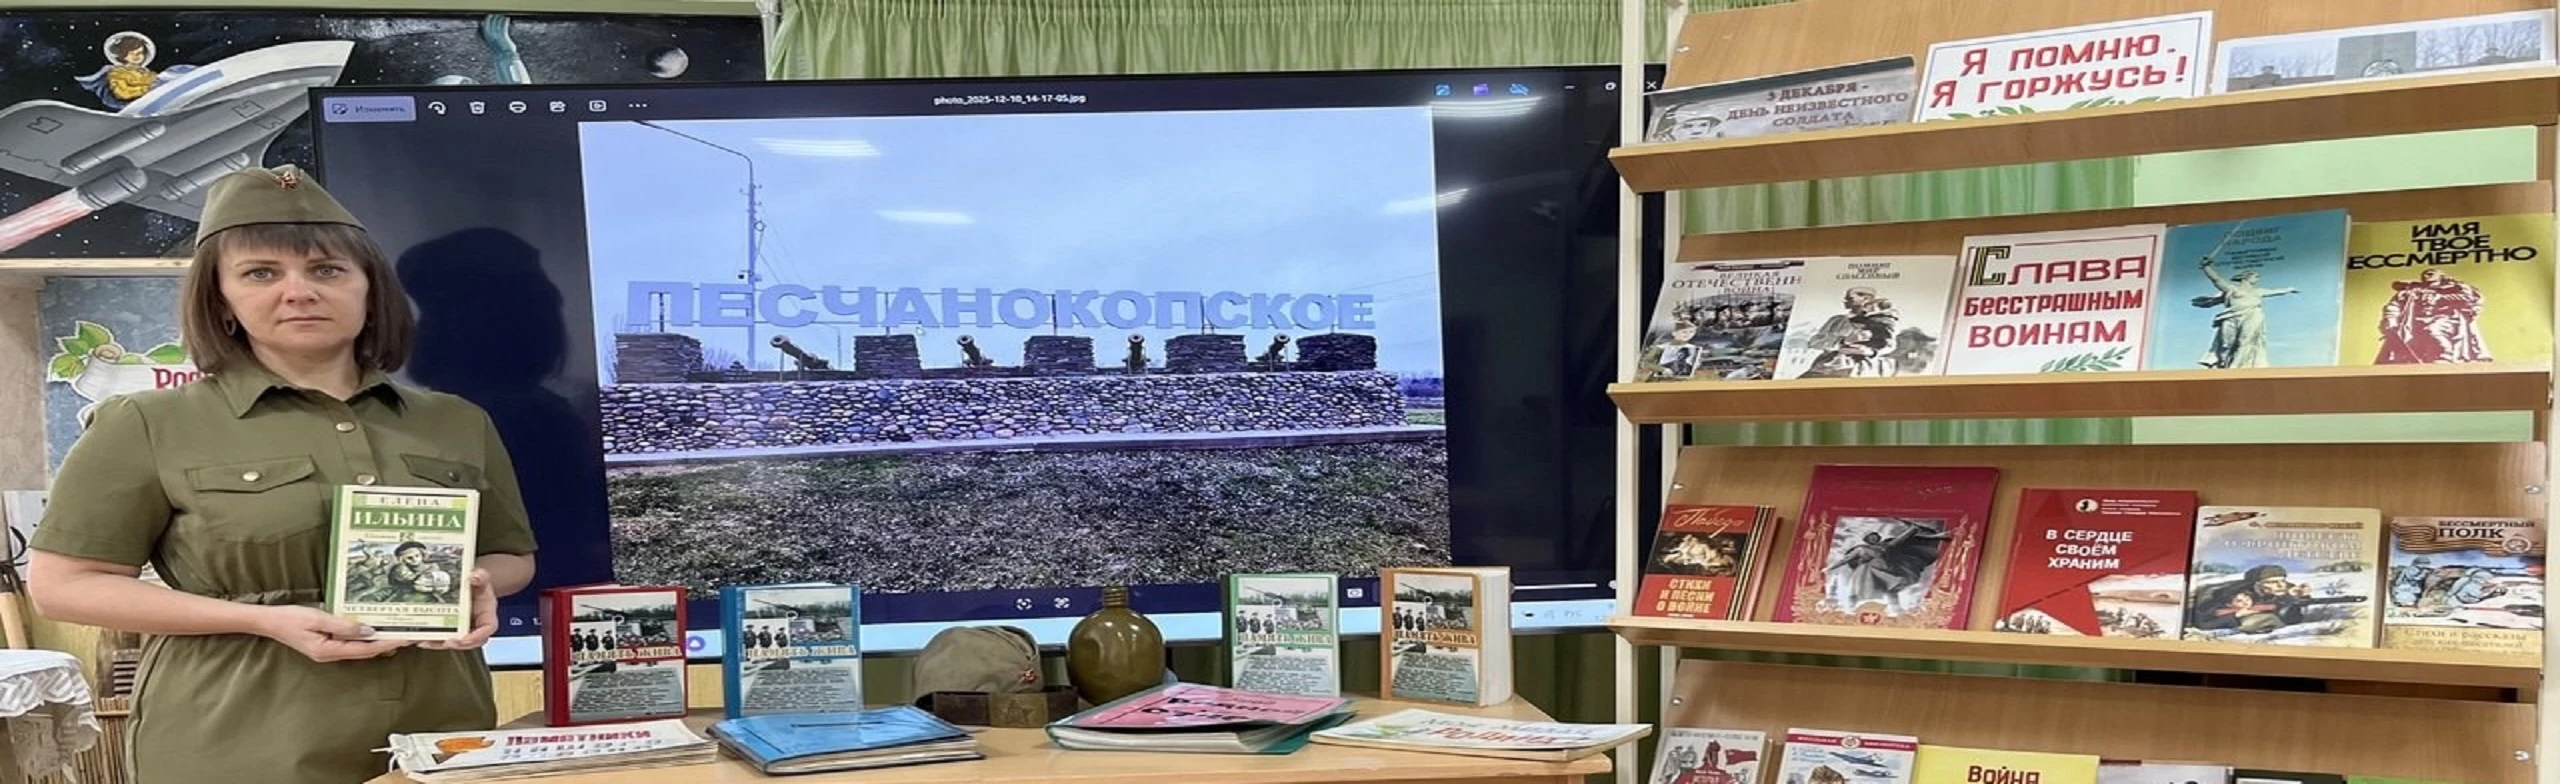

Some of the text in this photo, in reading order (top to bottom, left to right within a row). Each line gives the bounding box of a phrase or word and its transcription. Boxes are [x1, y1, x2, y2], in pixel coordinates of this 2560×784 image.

[1960, 48, 1989, 77] Я
[1930, 56, 2187, 108] Я ГОРЖУСЬ!
[1779, 82, 1858, 100] ДЕКАБРЯ
[1727, 92, 1909, 120] ДЕНЬ НЕИЗВЕСТНОГО
[1773, 111, 1855, 127] СОЛДАТА
[2412, 222, 2480, 239] ИМЯ
[2411, 235, 2491, 252] ТВОЕ
[1968, 245, 2146, 286] СЛАВА
[2348, 246, 2537, 269] ЕССМЕРТНО
[627, 281, 1376, 330] ПЕСЧАНОКОПСКОЕ
[1968, 320, 2127, 348] ВОИНАМ
[380, 494, 440, 506] ЕЛЕНА
[353, 511, 462, 528] ИЛЬИНА
[2437, 520, 2535, 528] БЕССМЕРТНЫЙ
[2045, 529, 2133, 544] В СЕРДЦЕ
[2438, 528, 2505, 538] ПОЛК
[2055, 543, 2117, 557] СВОЁМ
[2047, 557, 2120, 570] ХРАНИМ
[1668, 578, 1713, 589] СТИХИ
[1659, 589, 1715, 602] И ПЕСНИ
[1656, 601, 1713, 613] О ВОЙНЕ
